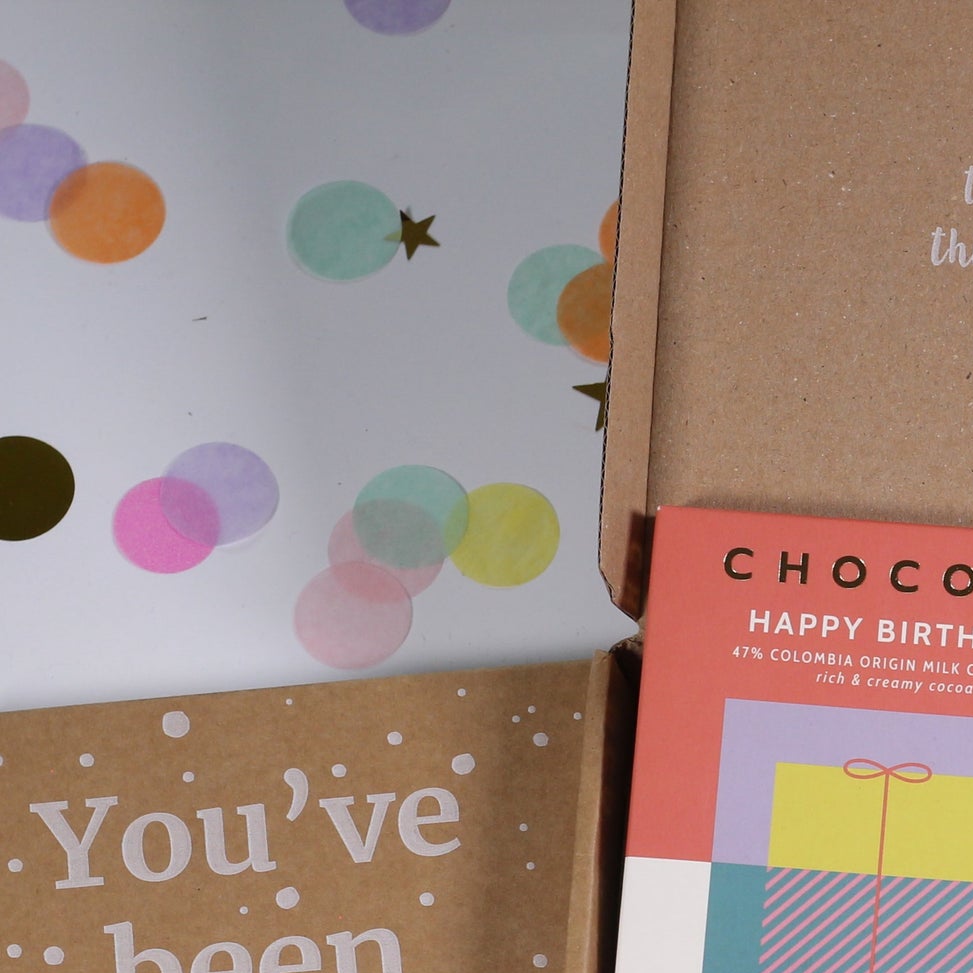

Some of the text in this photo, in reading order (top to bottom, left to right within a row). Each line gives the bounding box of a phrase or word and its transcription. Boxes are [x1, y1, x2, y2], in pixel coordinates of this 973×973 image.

[749, 609, 864, 640] HAPPY
[732, 646, 764, 660] 47%
[770, 648, 853, 667] COLOMBIA
[860, 655, 916, 671] ORIGIN
[923, 660, 960, 675] MILK
[816, 671, 973, 695] rich & creamy cocoa
